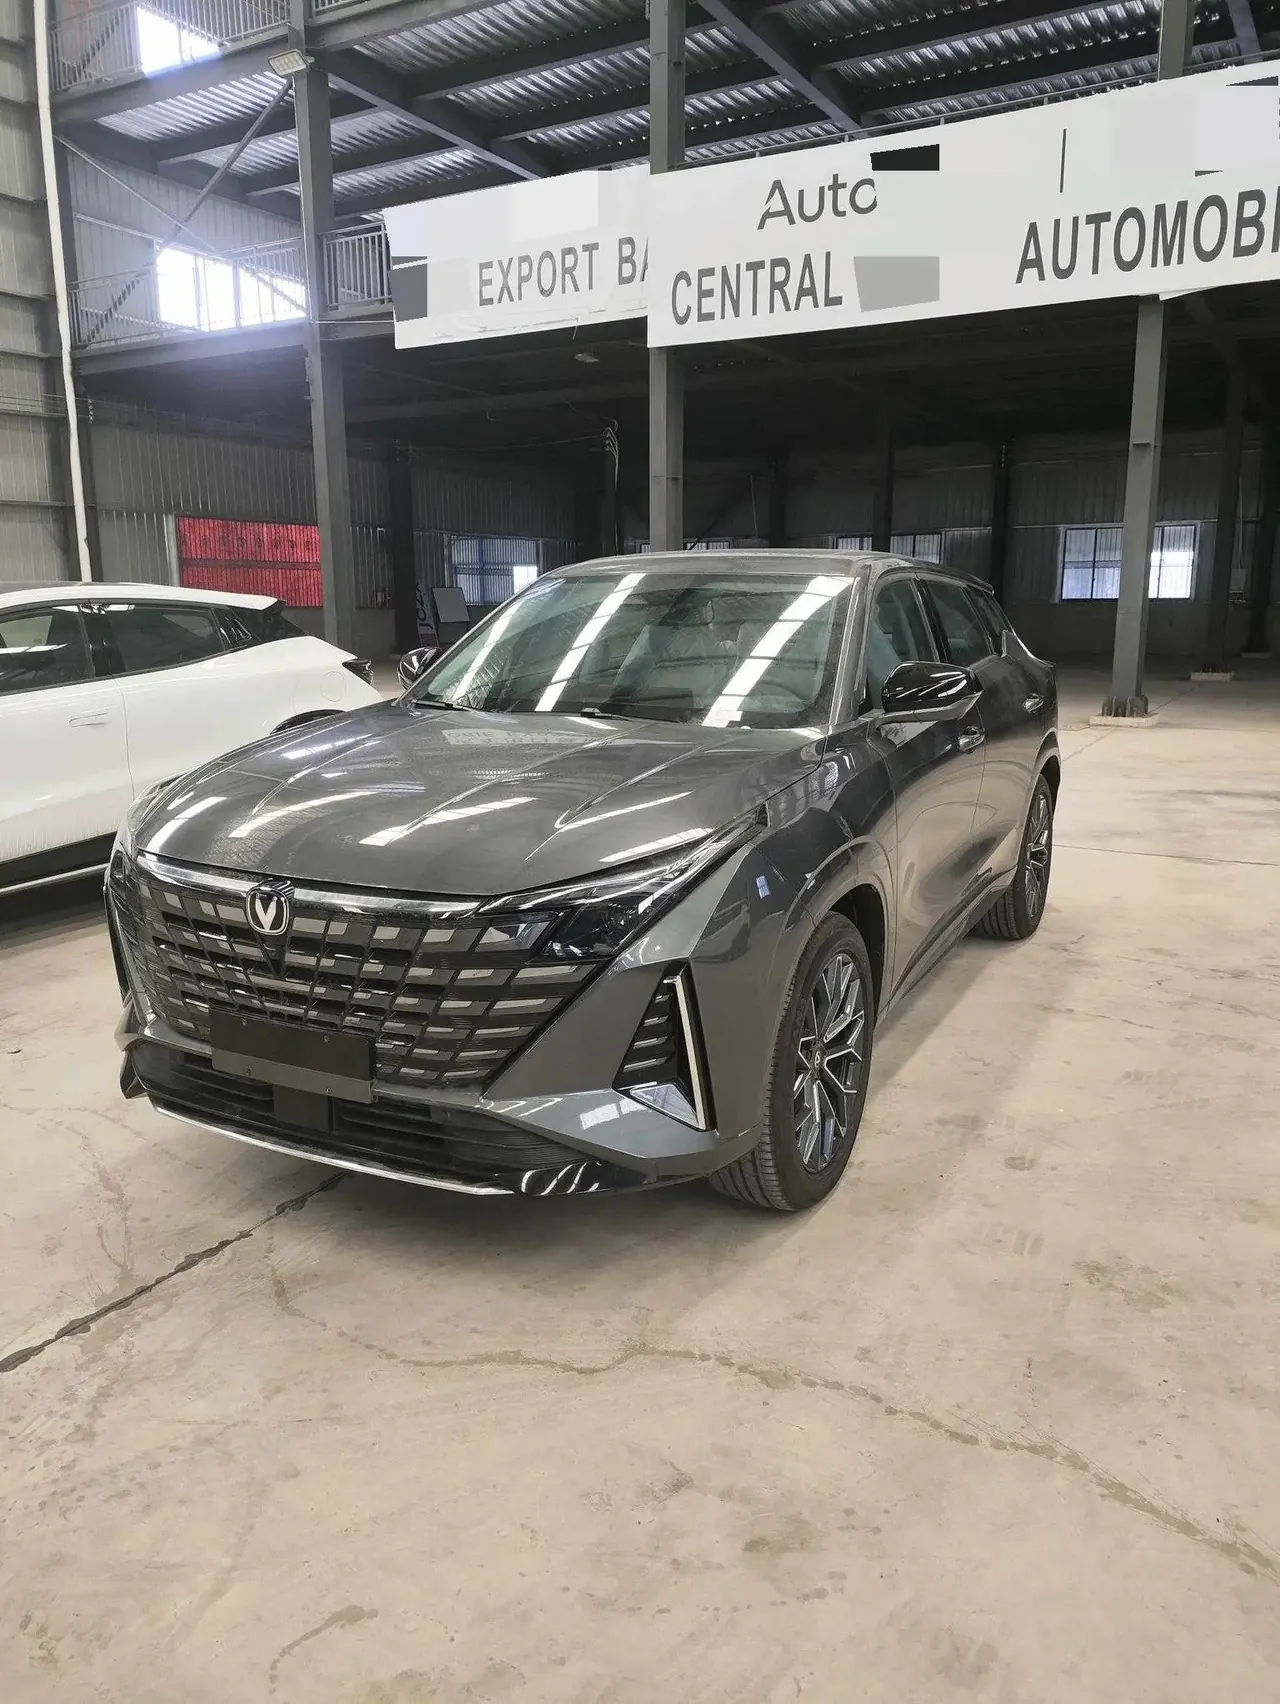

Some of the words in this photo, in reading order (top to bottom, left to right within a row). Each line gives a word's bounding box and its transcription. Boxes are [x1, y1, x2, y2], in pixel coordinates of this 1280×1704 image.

[757, 173, 878, 230] Auto
[479, 242, 599, 306] EXPORT
[671, 251, 843, 325] CENTRAL
